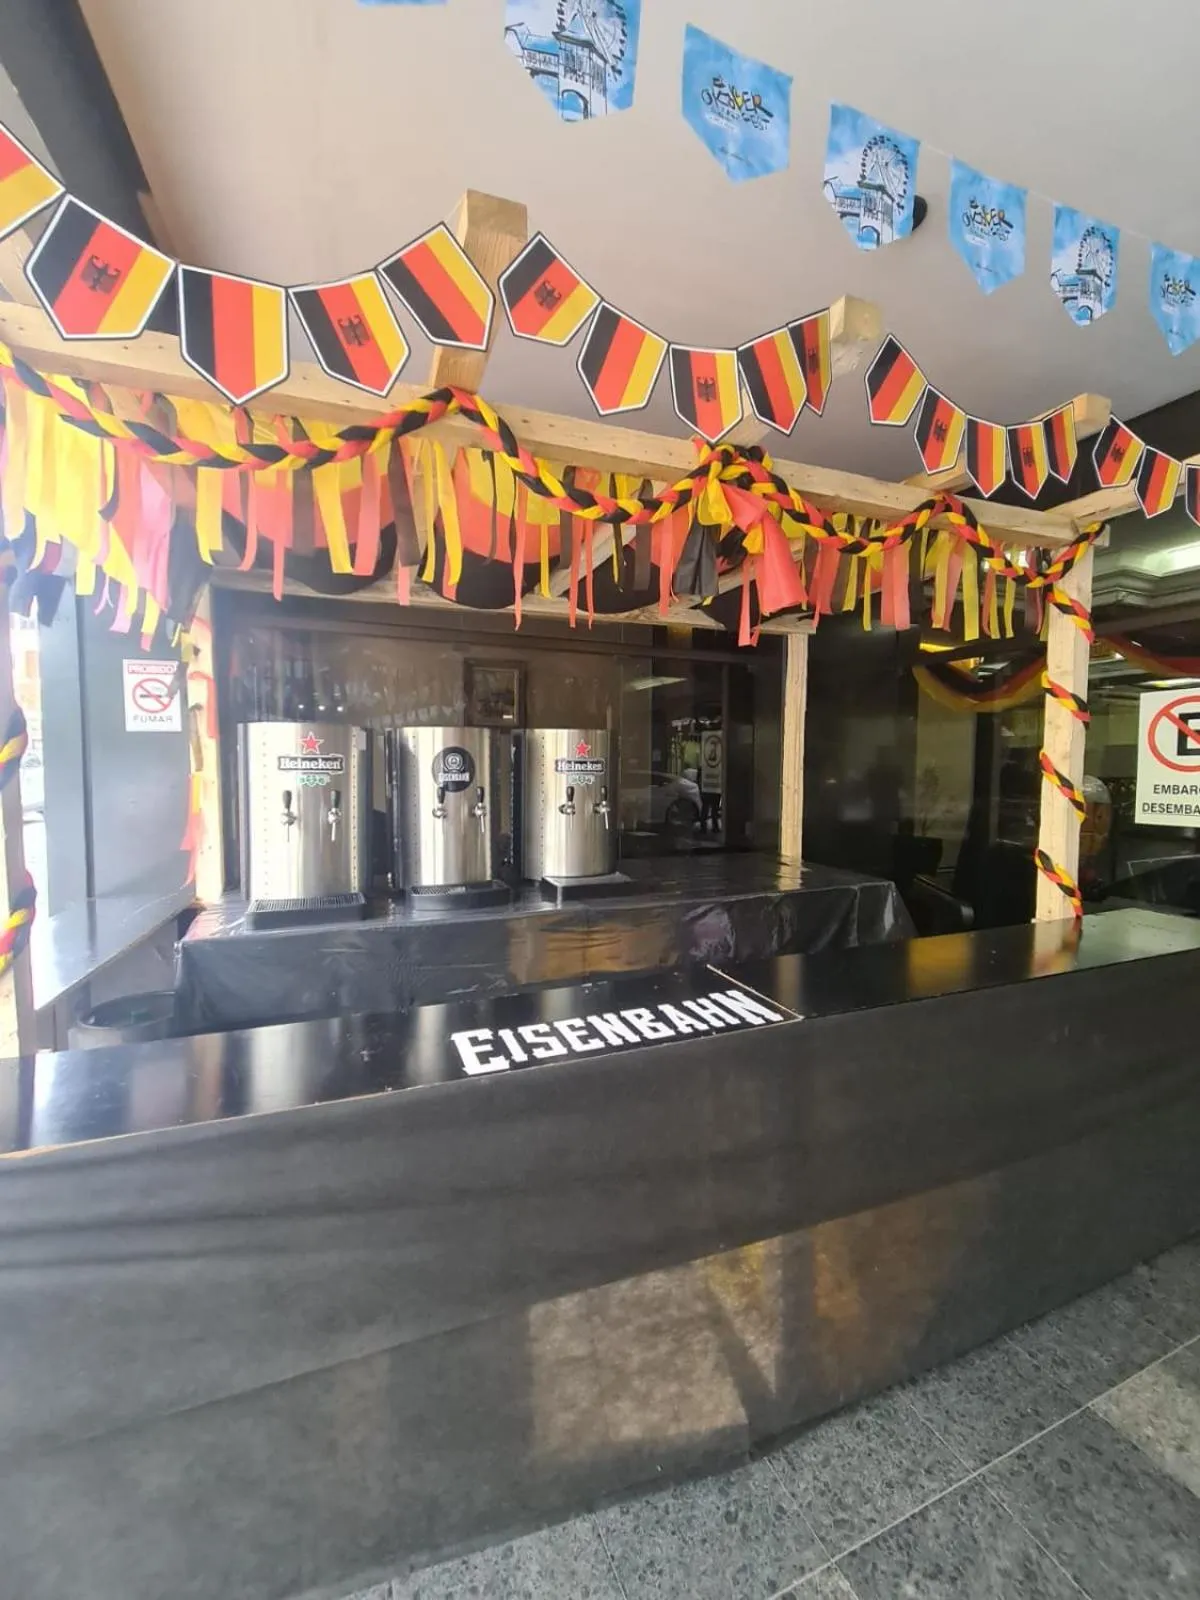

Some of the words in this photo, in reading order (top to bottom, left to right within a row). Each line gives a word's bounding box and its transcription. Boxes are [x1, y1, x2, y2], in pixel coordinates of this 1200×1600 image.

[133, 714, 173, 723] FUMAR
[280, 757, 341, 769] Heineken
[557, 761, 602, 770] Heineken
[1153, 784, 1200, 795] EMBAR
[451, 989, 784, 1076] EISENBAHN
